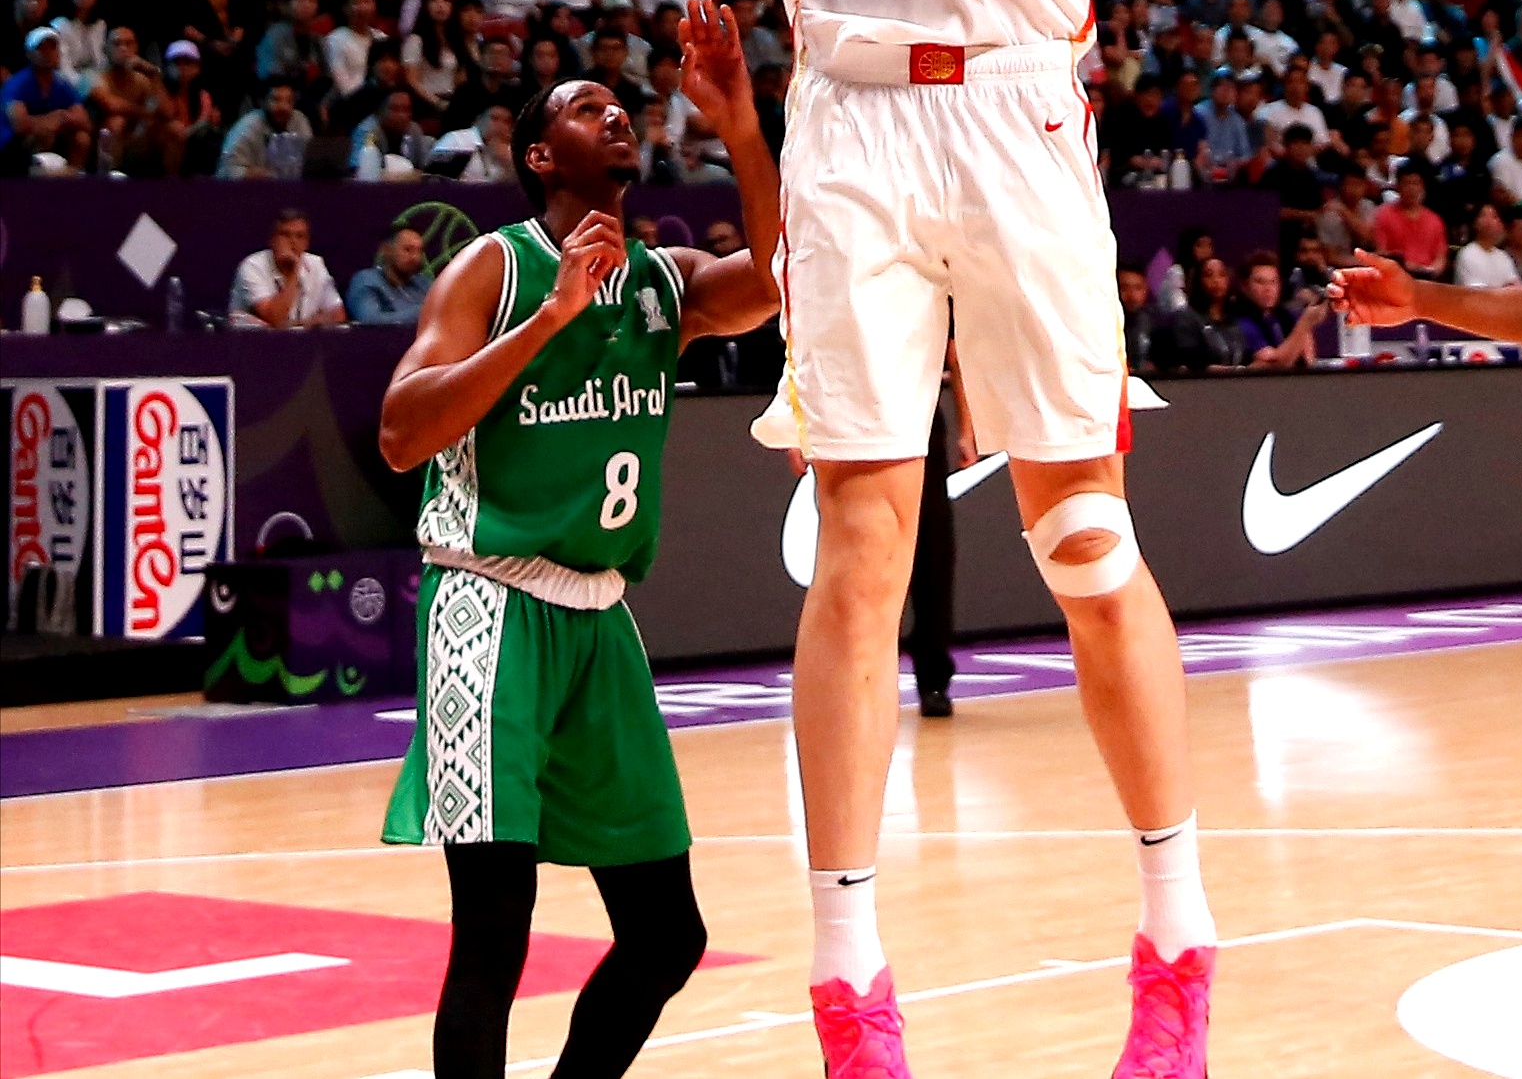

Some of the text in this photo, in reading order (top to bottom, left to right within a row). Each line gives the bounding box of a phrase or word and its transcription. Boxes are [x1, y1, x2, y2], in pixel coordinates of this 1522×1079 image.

[519, 377, 610, 426] Saudi
[180, 424, 209, 576] 百岁山
[600, 451, 641, 530] 8
